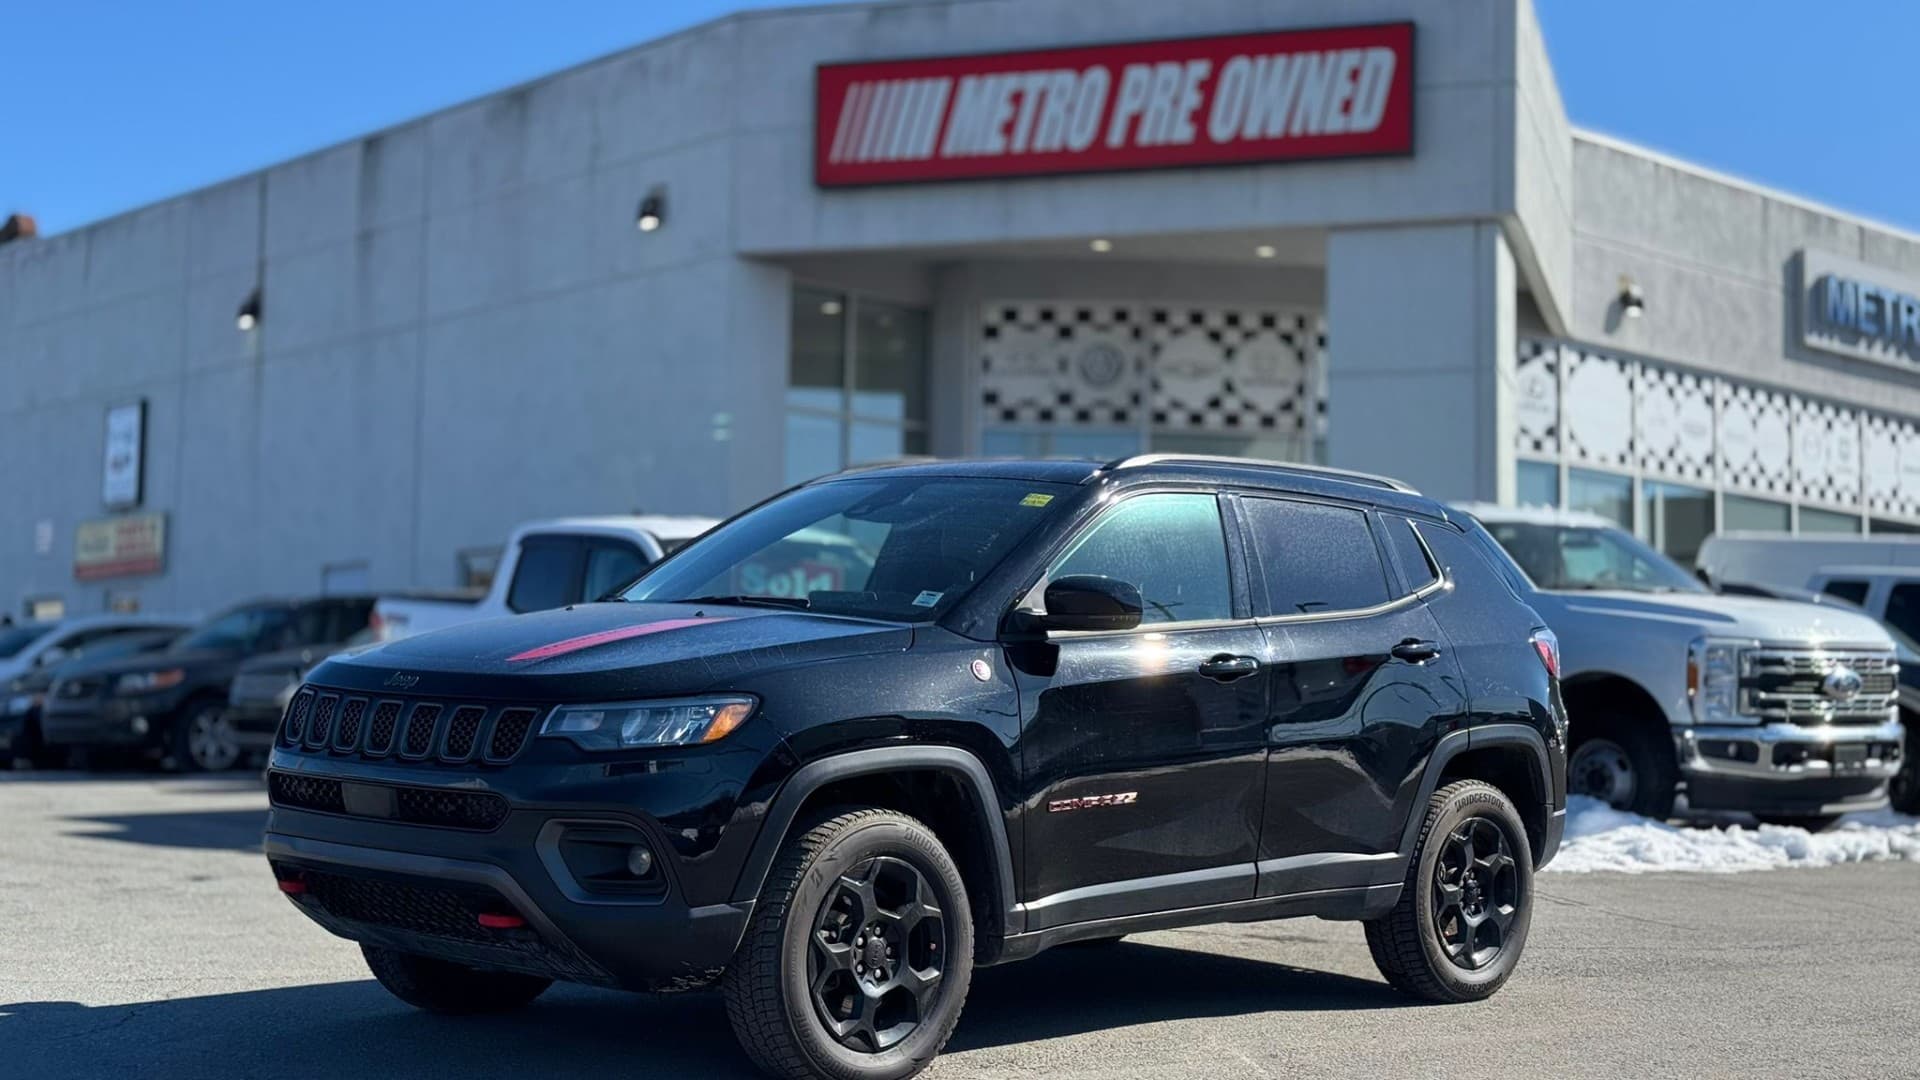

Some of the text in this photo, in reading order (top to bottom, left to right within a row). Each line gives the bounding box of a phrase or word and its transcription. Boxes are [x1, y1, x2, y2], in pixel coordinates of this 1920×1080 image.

[942, 48, 1396, 157] METRO PRE OWNED
[1454, 792, 1505, 813] BRIDGESTONE
[903, 826, 964, 902] BRIDGESTONE
